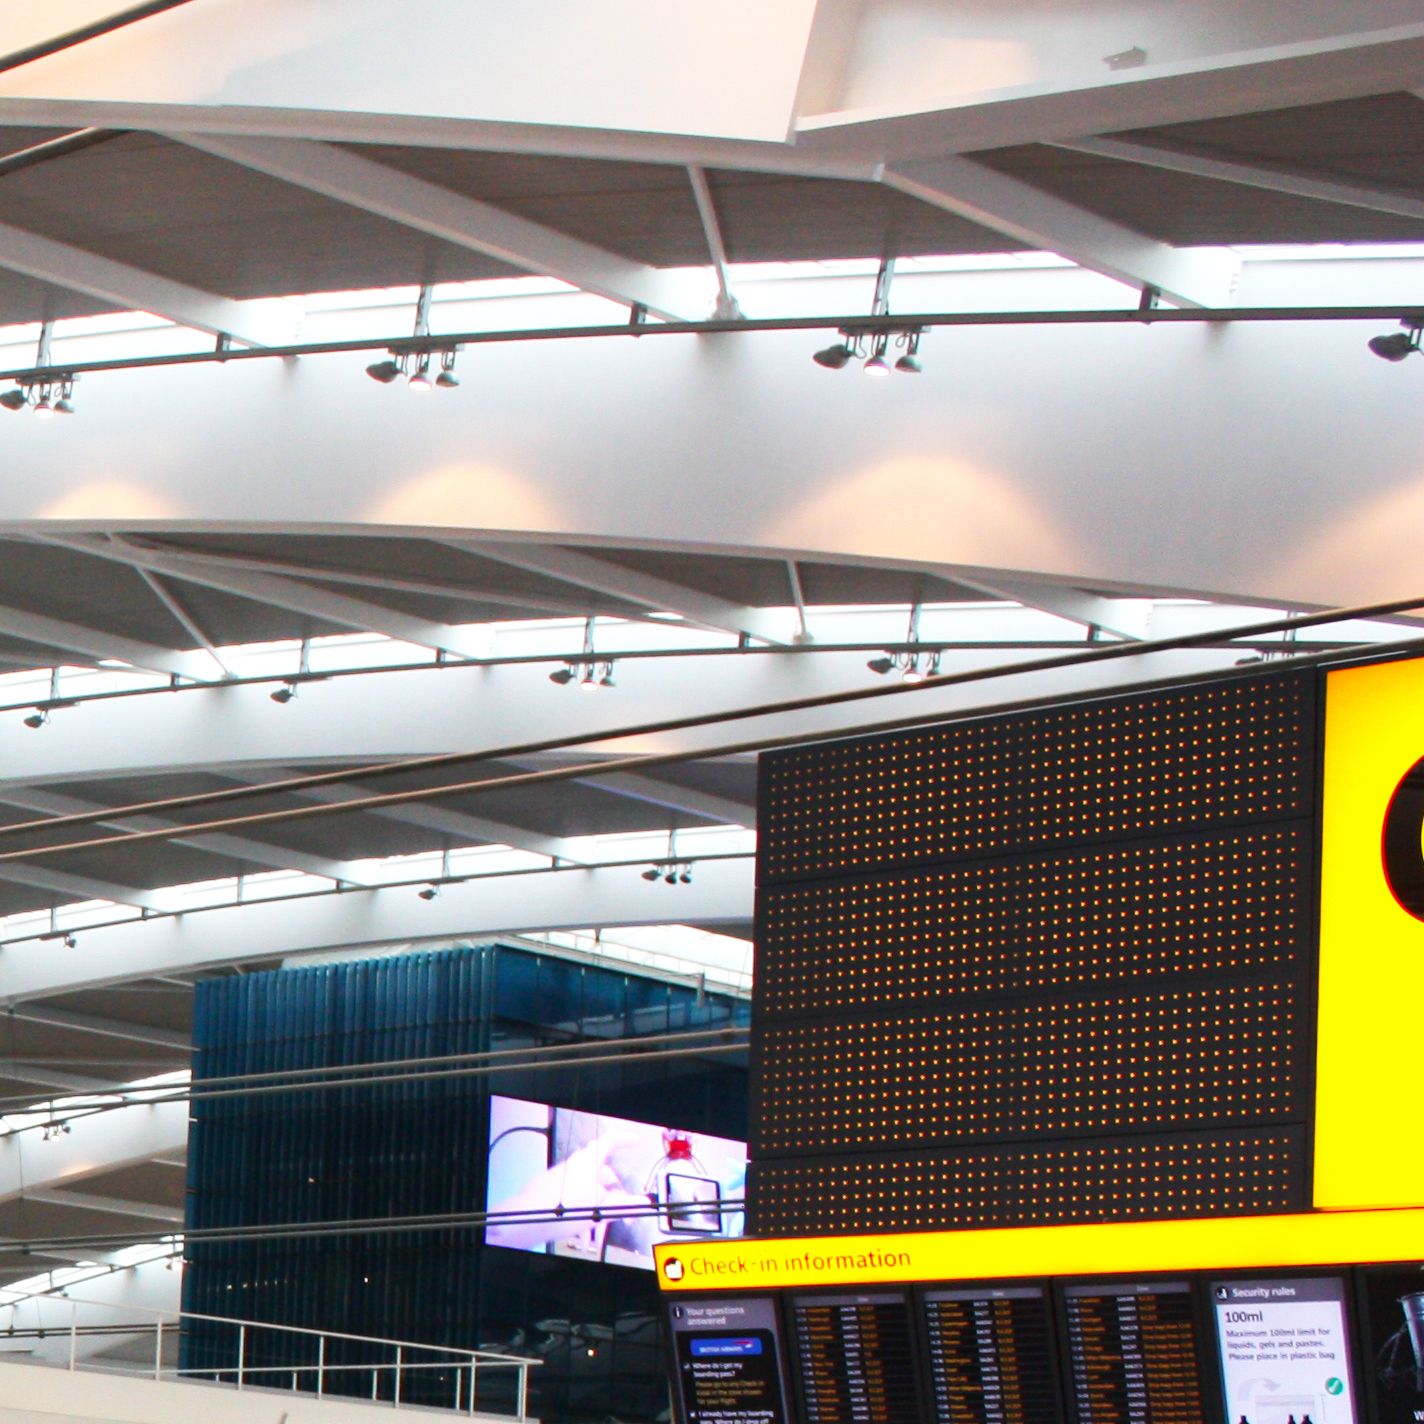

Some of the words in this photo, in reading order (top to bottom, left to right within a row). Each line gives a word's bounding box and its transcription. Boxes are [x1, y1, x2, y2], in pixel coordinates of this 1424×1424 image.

[690, 1255, 779, 1276] Check-in
[784, 1250, 912, 1271] information
[1232, 1287, 1270, 1299] Security
[1271, 1286, 1296, 1297] rules
[705, 1307, 745, 1317] questions
[1224, 1310, 1264, 1323] 100ml
[687, 1316, 726, 1326] answered
[1226, 1329, 1268, 1338] Maximum
[1270, 1328, 1295, 1337] 100ml
[1297, 1328, 1316, 1336] limit
[1318, 1328, 1330, 1336] for
[1227, 1341, 1257, 1350] liquids,
[1258, 1340, 1276, 1350] gels
[1278, 1340, 1294, 1348] and
[1295, 1339, 1325, 1349] pastes.
[1228, 1352, 1254, 1361] Please
[1256, 1352, 1278, 1362] place
[1279, 1352, 1288, 1360] in
[1290, 1351, 1317, 1361] plastic
[1319, 1351, 1336, 1361] bag
